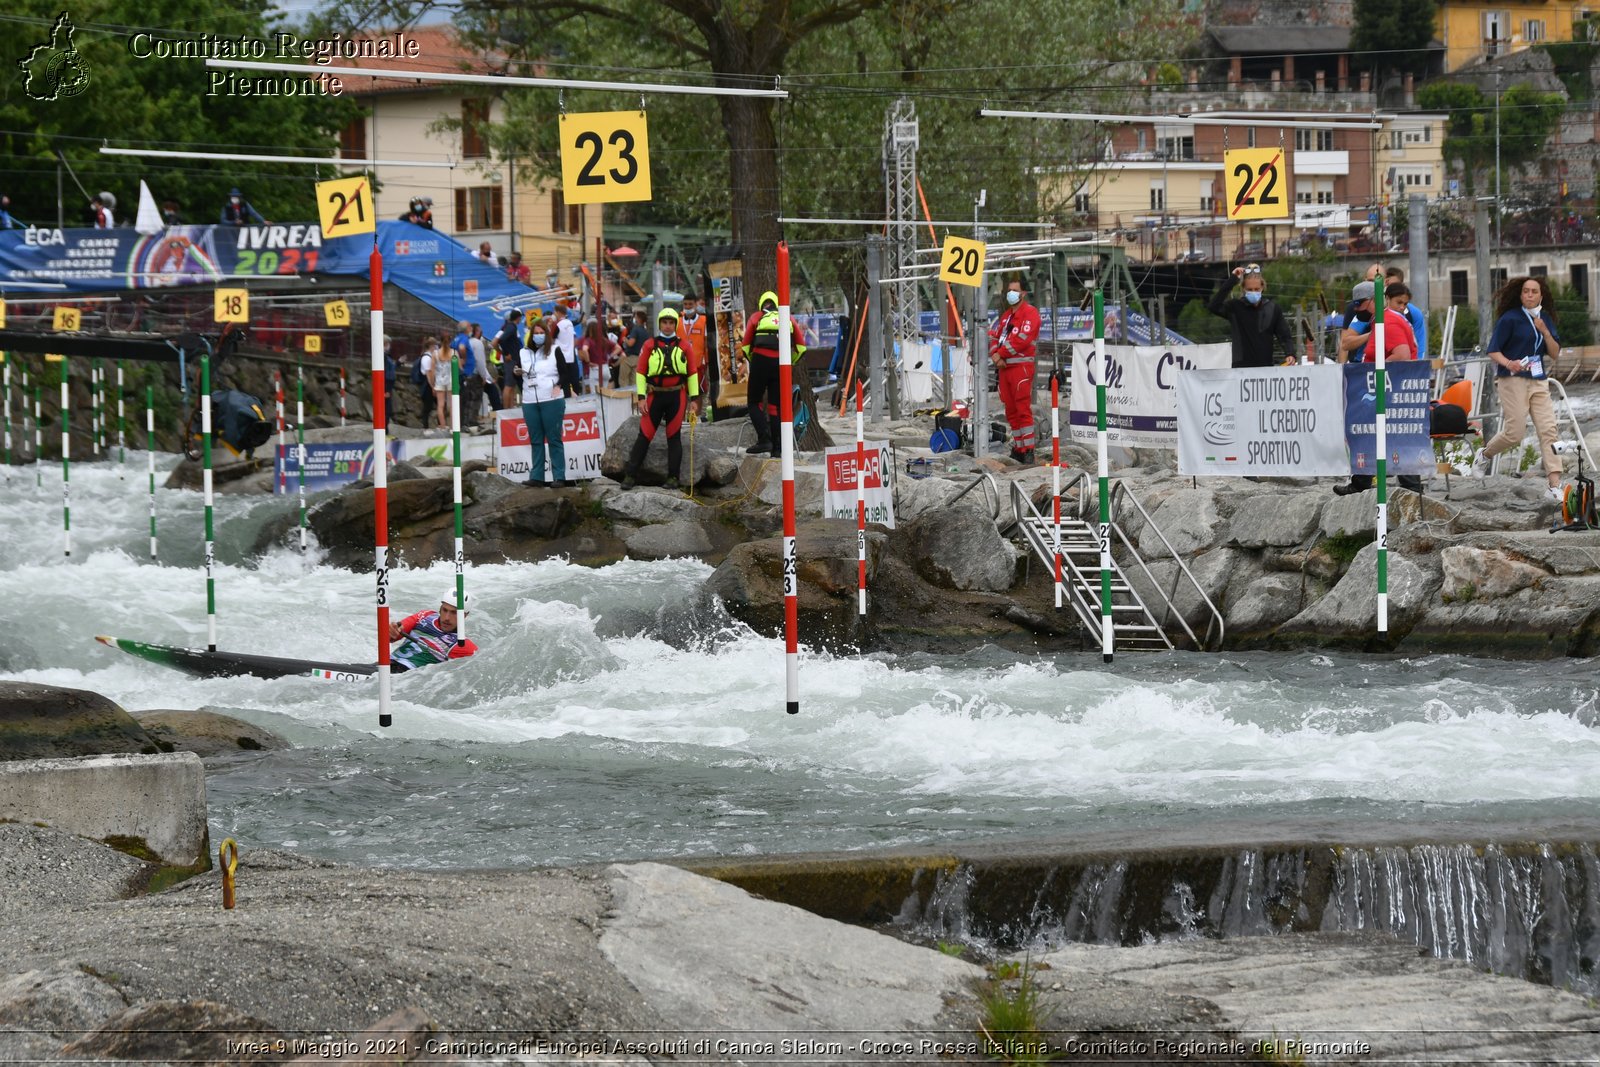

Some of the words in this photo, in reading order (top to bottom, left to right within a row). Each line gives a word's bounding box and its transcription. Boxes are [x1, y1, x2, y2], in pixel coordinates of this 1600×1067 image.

[575, 129, 638, 186] 23
[1234, 162, 1279, 206] 22
[329, 188, 365, 226] 21
[24, 228, 66, 246] ECA
[78, 238, 120, 247] CANOE
[237, 225, 322, 250] IVREA
[410, 240, 439, 248] REGIONE
[66, 248, 116, 258] SLALOM
[233, 249, 320, 275] 2021
[947, 246, 979, 276] 20
[720, 277, 732, 311] KIND
[222, 296, 242, 316] 18
[330, 305, 345, 320] 15
[61, 312, 75, 329] 16
[1240, 377, 1286, 402] ISTITUTO
[1289, 376, 1310, 401] PER
[1366, 371, 1393, 393] EA
[1401, 379, 1430, 390] CANOE
[1203, 393, 1223, 416] ICS
[1385, 408, 1426, 419] UROPEAN
[1259, 409, 1268, 433] IL
[1270, 408, 1316, 433] CREDITO
[1351, 423, 1424, 435] CHAMONSHIPS
[334, 449, 363, 461] IVREA
[1247, 441, 1301, 465] SPORTIVO
[334, 461, 362, 474] 2021
[500, 461, 530, 475] PIAZZA
[569, 457, 579, 470] 21
[834, 456, 880, 484] DESAR
